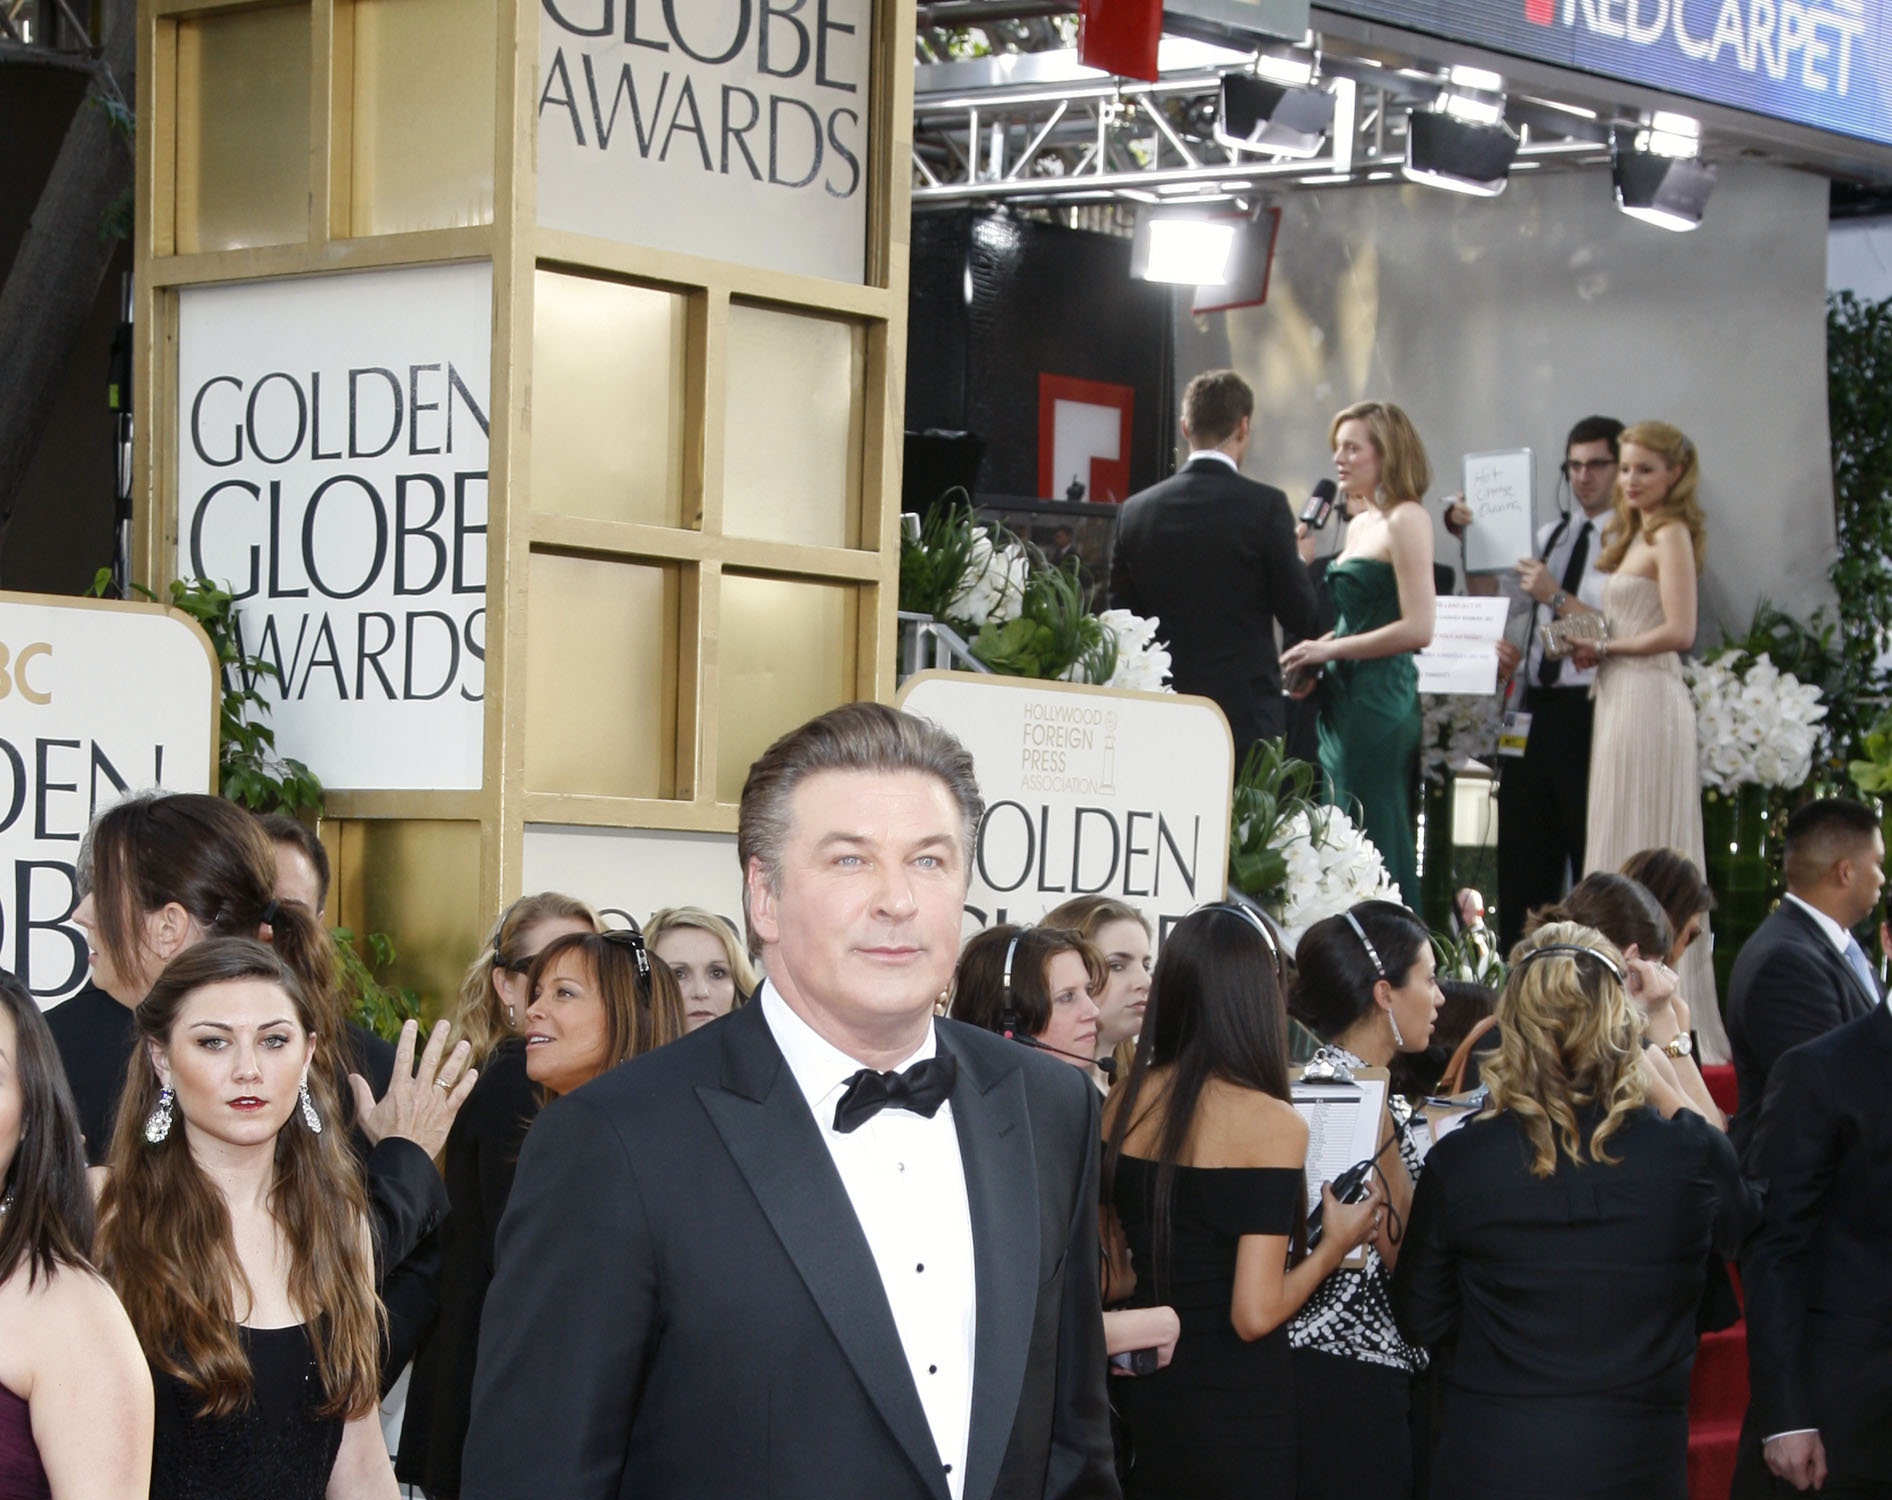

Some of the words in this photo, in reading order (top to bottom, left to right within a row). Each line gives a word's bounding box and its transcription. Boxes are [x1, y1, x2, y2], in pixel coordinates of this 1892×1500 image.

[539, 46, 860, 199] AWARDS
[191, 360, 490, 467] GOLDEN
[190, 471, 488, 600] GLOBE
[221, 607, 486, 701] WARDS
[1022, 748, 1066, 773] PRESS
[1023, 723, 1094, 750] FOREIGN
[1024, 703, 1102, 726] HOLLYWOOD
[1021, 774, 1099, 796] ASSOCIATION
[976, 799, 1200, 901] OLDEN
